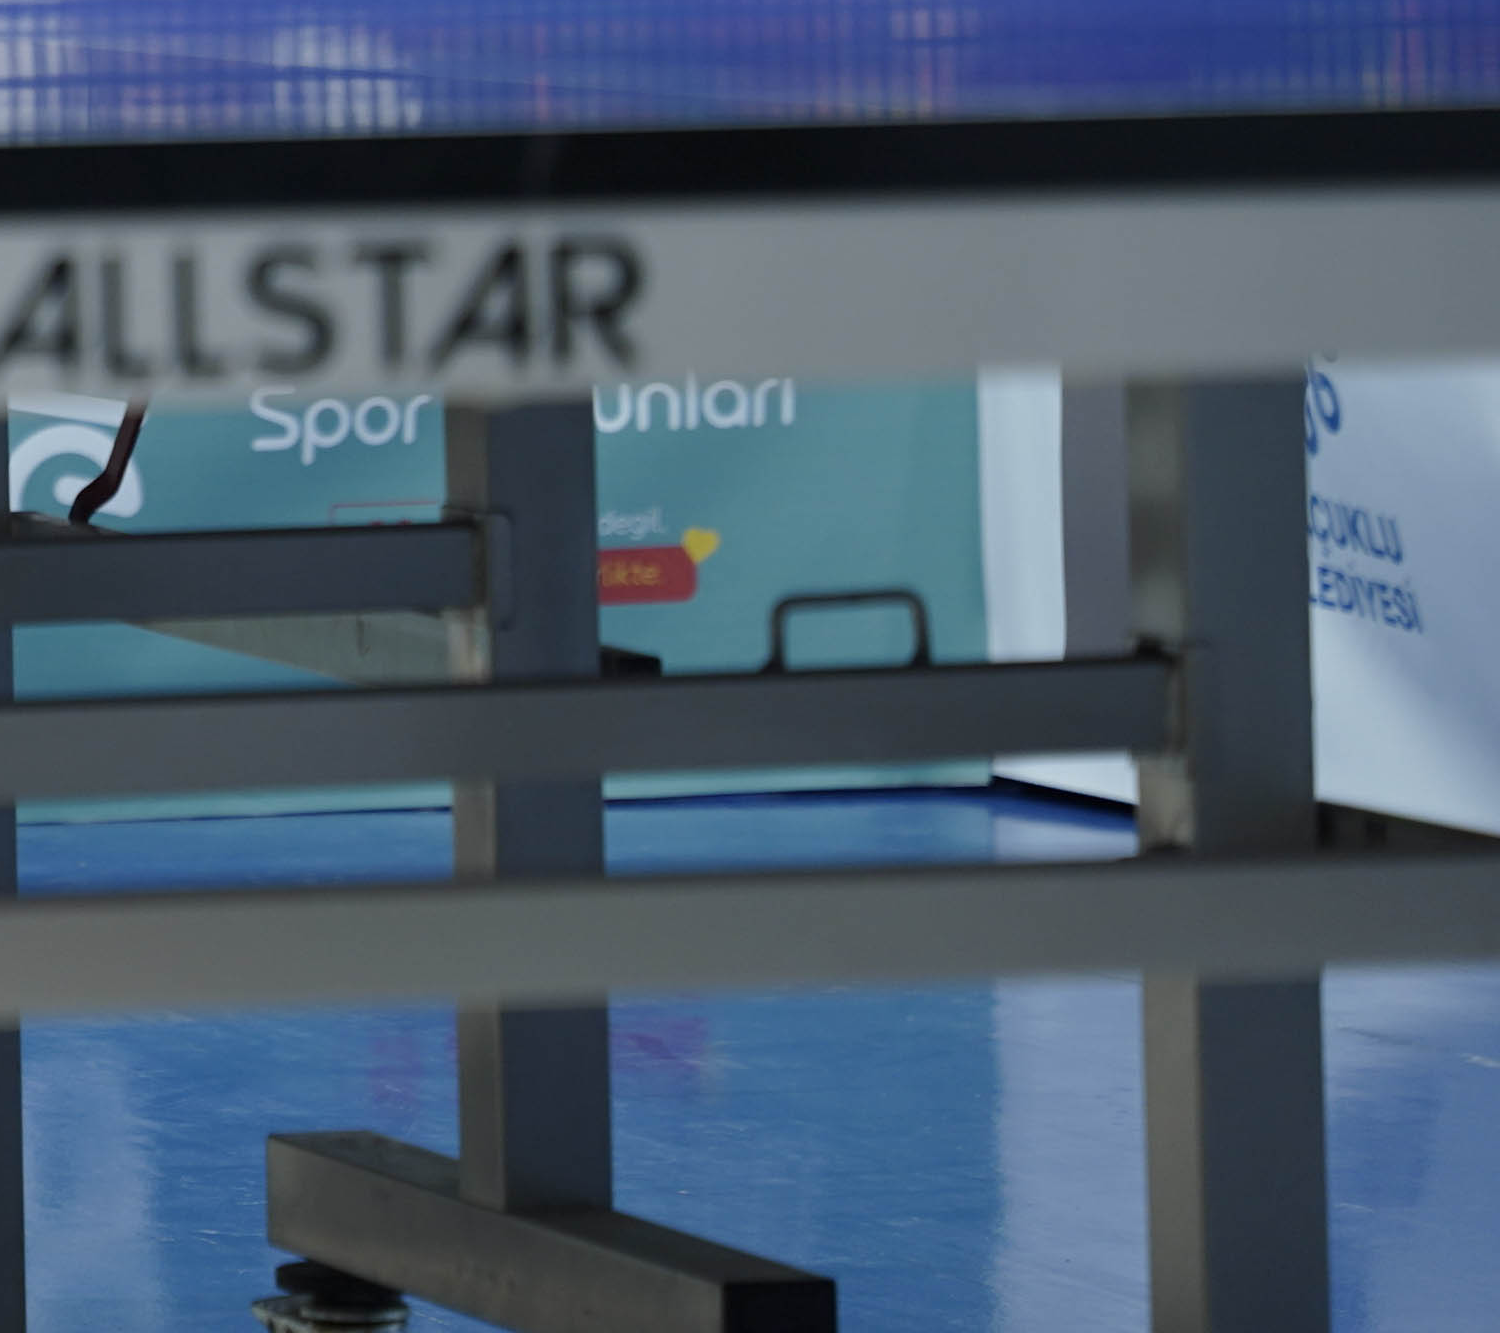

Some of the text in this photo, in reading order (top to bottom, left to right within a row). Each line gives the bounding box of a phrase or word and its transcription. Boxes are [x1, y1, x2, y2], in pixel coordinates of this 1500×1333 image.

[248, 369, 796, 466] Spor unları
[1308, 494, 1404, 566] ÇUKLU
[1310, 563, 1424, 634] EDİYESİ
